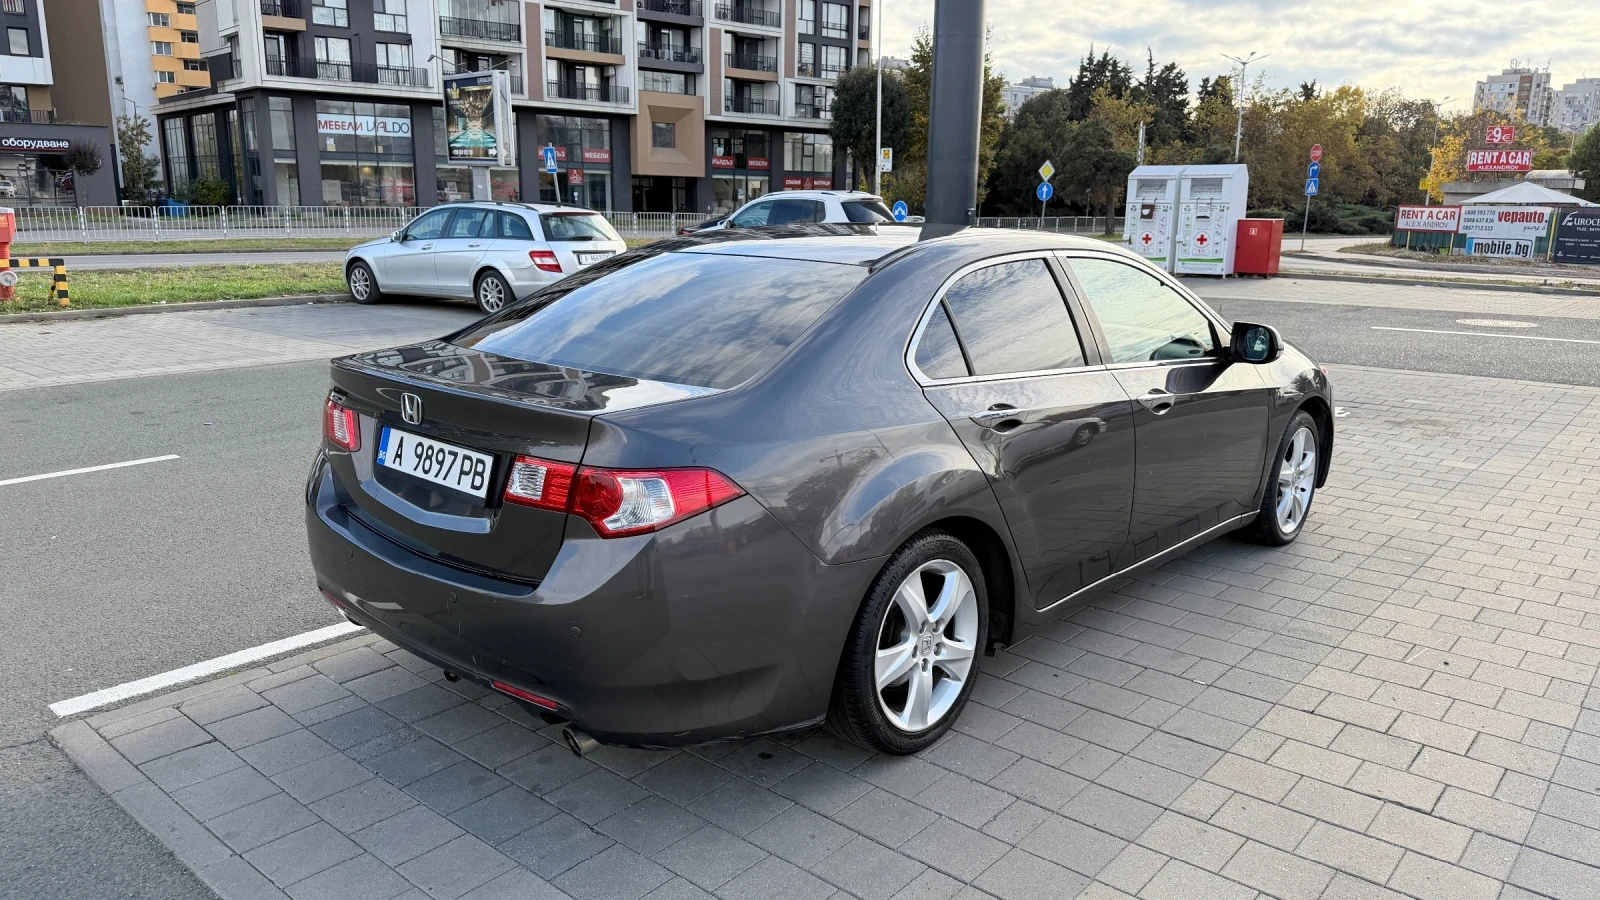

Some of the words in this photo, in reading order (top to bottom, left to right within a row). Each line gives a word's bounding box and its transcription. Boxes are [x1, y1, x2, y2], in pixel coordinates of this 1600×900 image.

[317, 120, 363, 131] МЕБЕЛИ
[1, 137, 70, 149] оборудване
[1470, 151, 1499, 165] RENT
[1500, 151, 1507, 164] A
[1509, 152, 1530, 165] CAR
[1401, 209, 1425, 219] RENT
[1427, 210, 1434, 220] A
[1436, 210, 1456, 220] CAR
[1474, 240, 1530, 258] mobile.bg
[378, 449, 387, 460] BG
[393, 436, 404, 466] A
